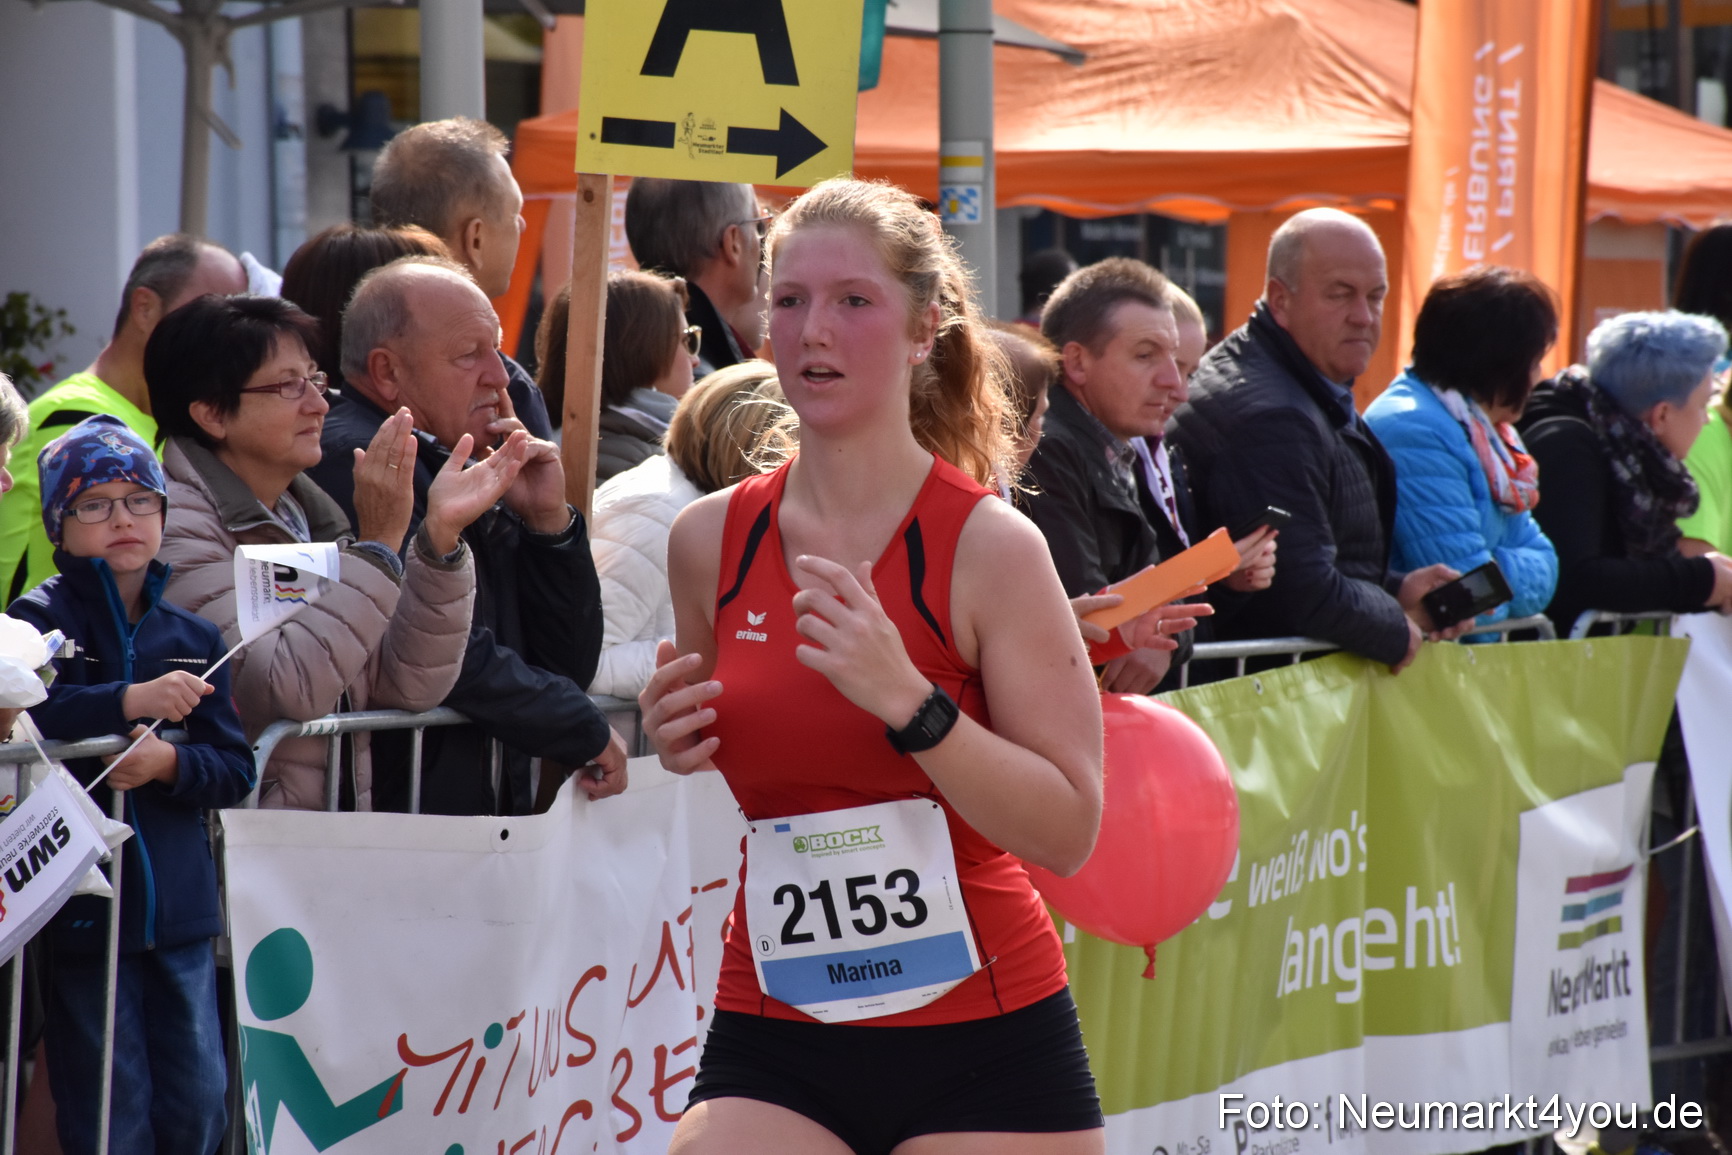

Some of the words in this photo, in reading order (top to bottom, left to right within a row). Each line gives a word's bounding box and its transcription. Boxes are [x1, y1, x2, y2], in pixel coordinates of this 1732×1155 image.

[639, 0, 800, 87] A
[735, 628, 768, 642] erima
[18, 805, 59, 851] stadtwerke
[809, 825, 884, 852] BOCK
[3, 816, 71, 893] swn
[841, 846, 858, 854] smart
[1248, 829, 1309, 908] weiß
[773, 868, 928, 946] 2153
[761, 940, 770, 952] D
[826, 958, 903, 985] Marina
